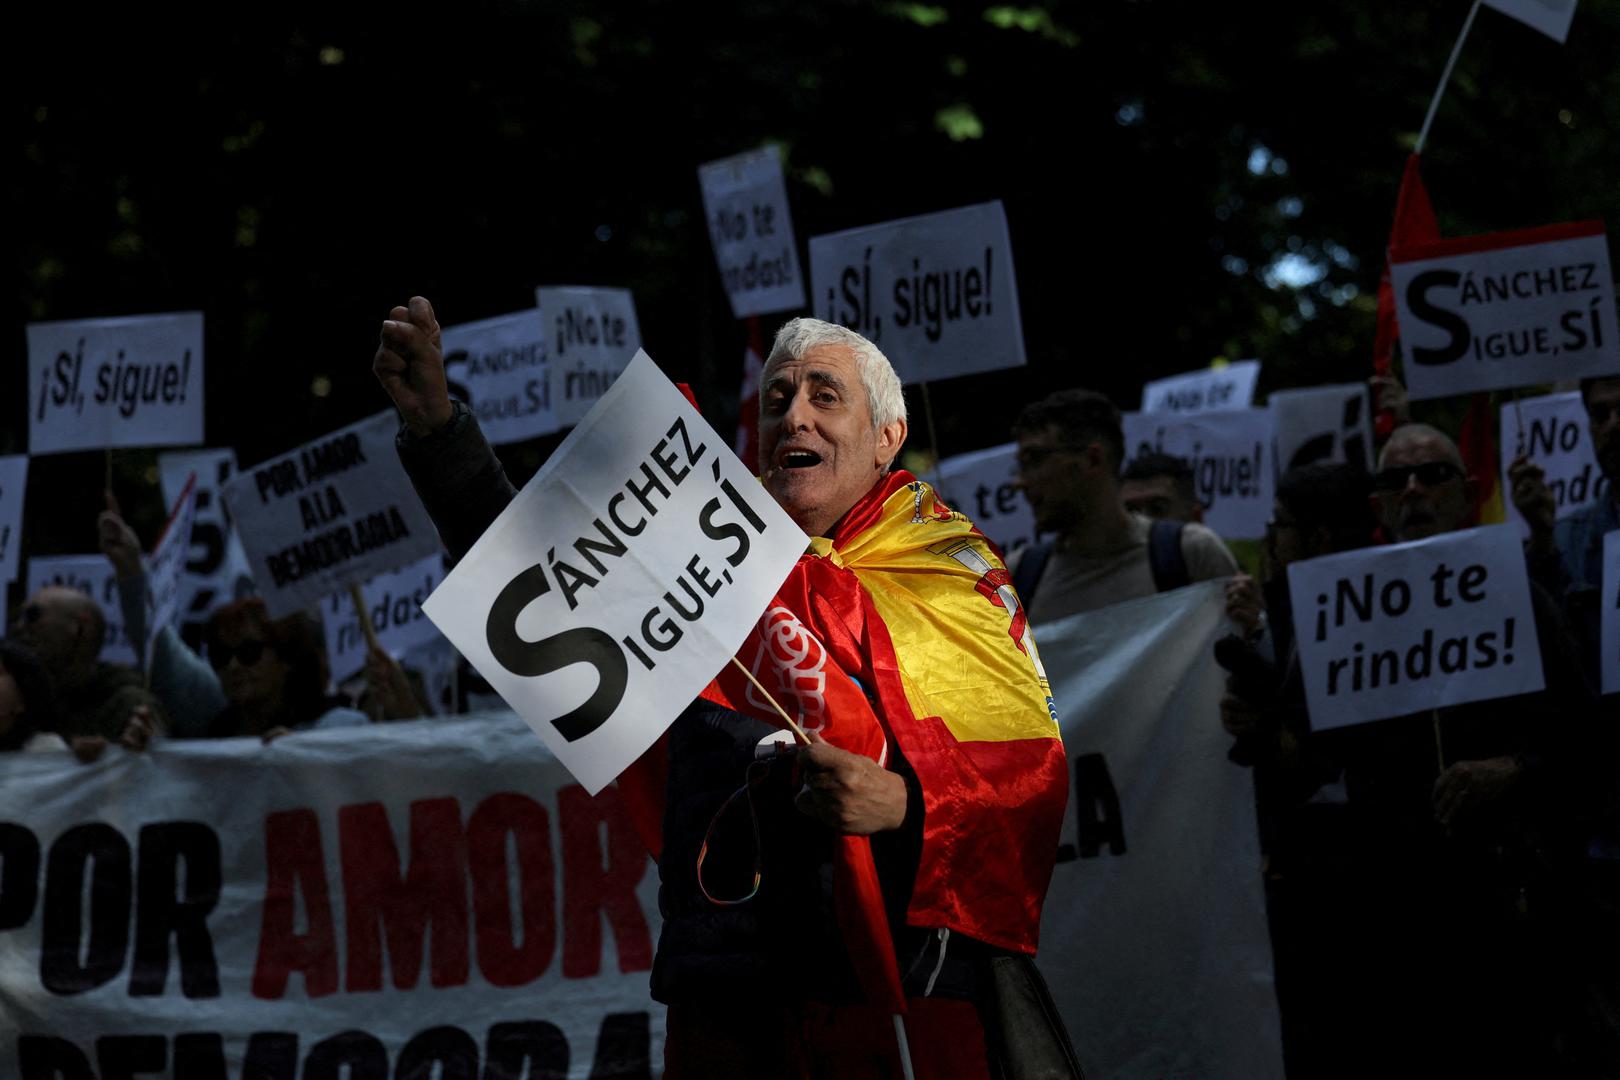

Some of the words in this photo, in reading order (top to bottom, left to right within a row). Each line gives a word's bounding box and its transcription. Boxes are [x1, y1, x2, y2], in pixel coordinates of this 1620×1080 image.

[893, 246, 992, 341] sigue!
[95, 349, 192, 418] sigue!
[976, 484, 1017, 519] te
[1316, 574, 1411, 642] ¡No
[1431, 563, 1487, 608] te
[1327, 618, 1515, 696] rindas!
[251, 784, 653, 999] AMOR
